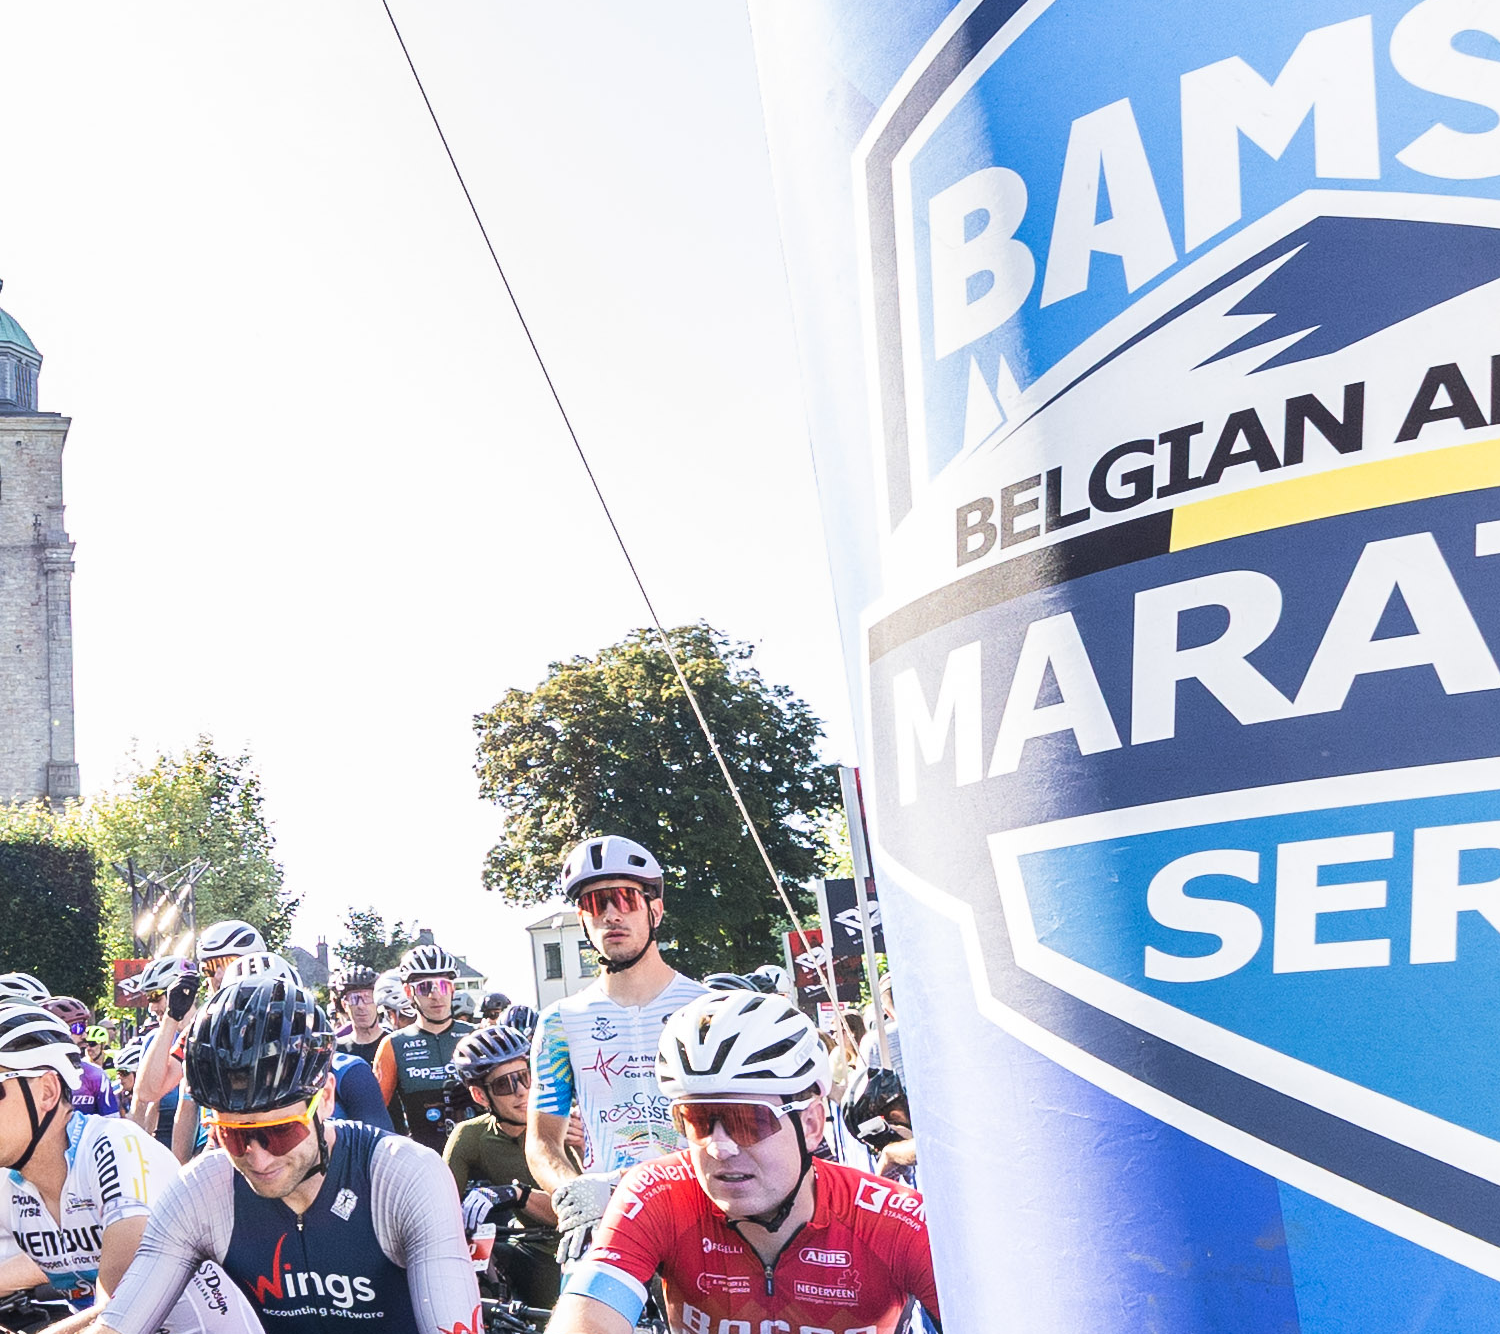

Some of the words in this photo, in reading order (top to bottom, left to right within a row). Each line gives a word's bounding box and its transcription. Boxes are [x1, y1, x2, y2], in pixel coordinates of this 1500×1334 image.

[956, 380, 1367, 567] BELGIAN
[403, 1039, 428, 1049] ARES
[627, 1055, 656, 1063] Arthu
[804, 1250, 847, 1265] ABUS
[246, 1233, 376, 1309] Wings
[796, 1283, 856, 1299] NEDERVEEN
[329, 1306, 385, 1319] software
